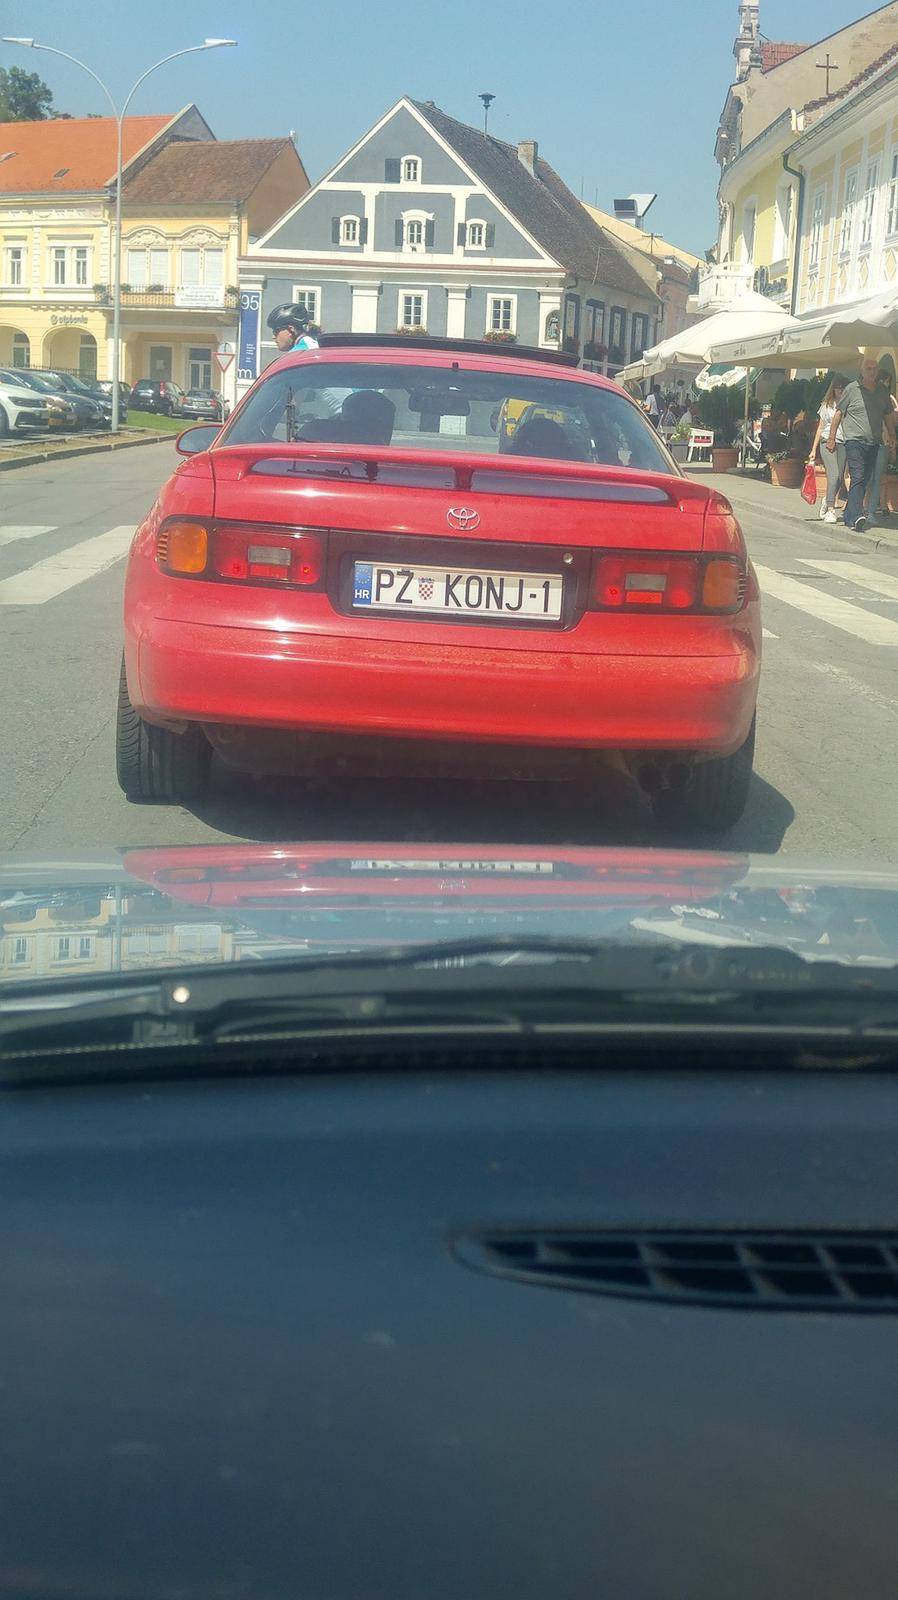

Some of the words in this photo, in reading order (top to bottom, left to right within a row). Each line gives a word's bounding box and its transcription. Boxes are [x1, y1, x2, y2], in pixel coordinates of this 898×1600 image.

[354, 589, 370, 600] HR
[375, 568, 415, 604] PŽ
[444, 574, 550, 613] KONJ-1
